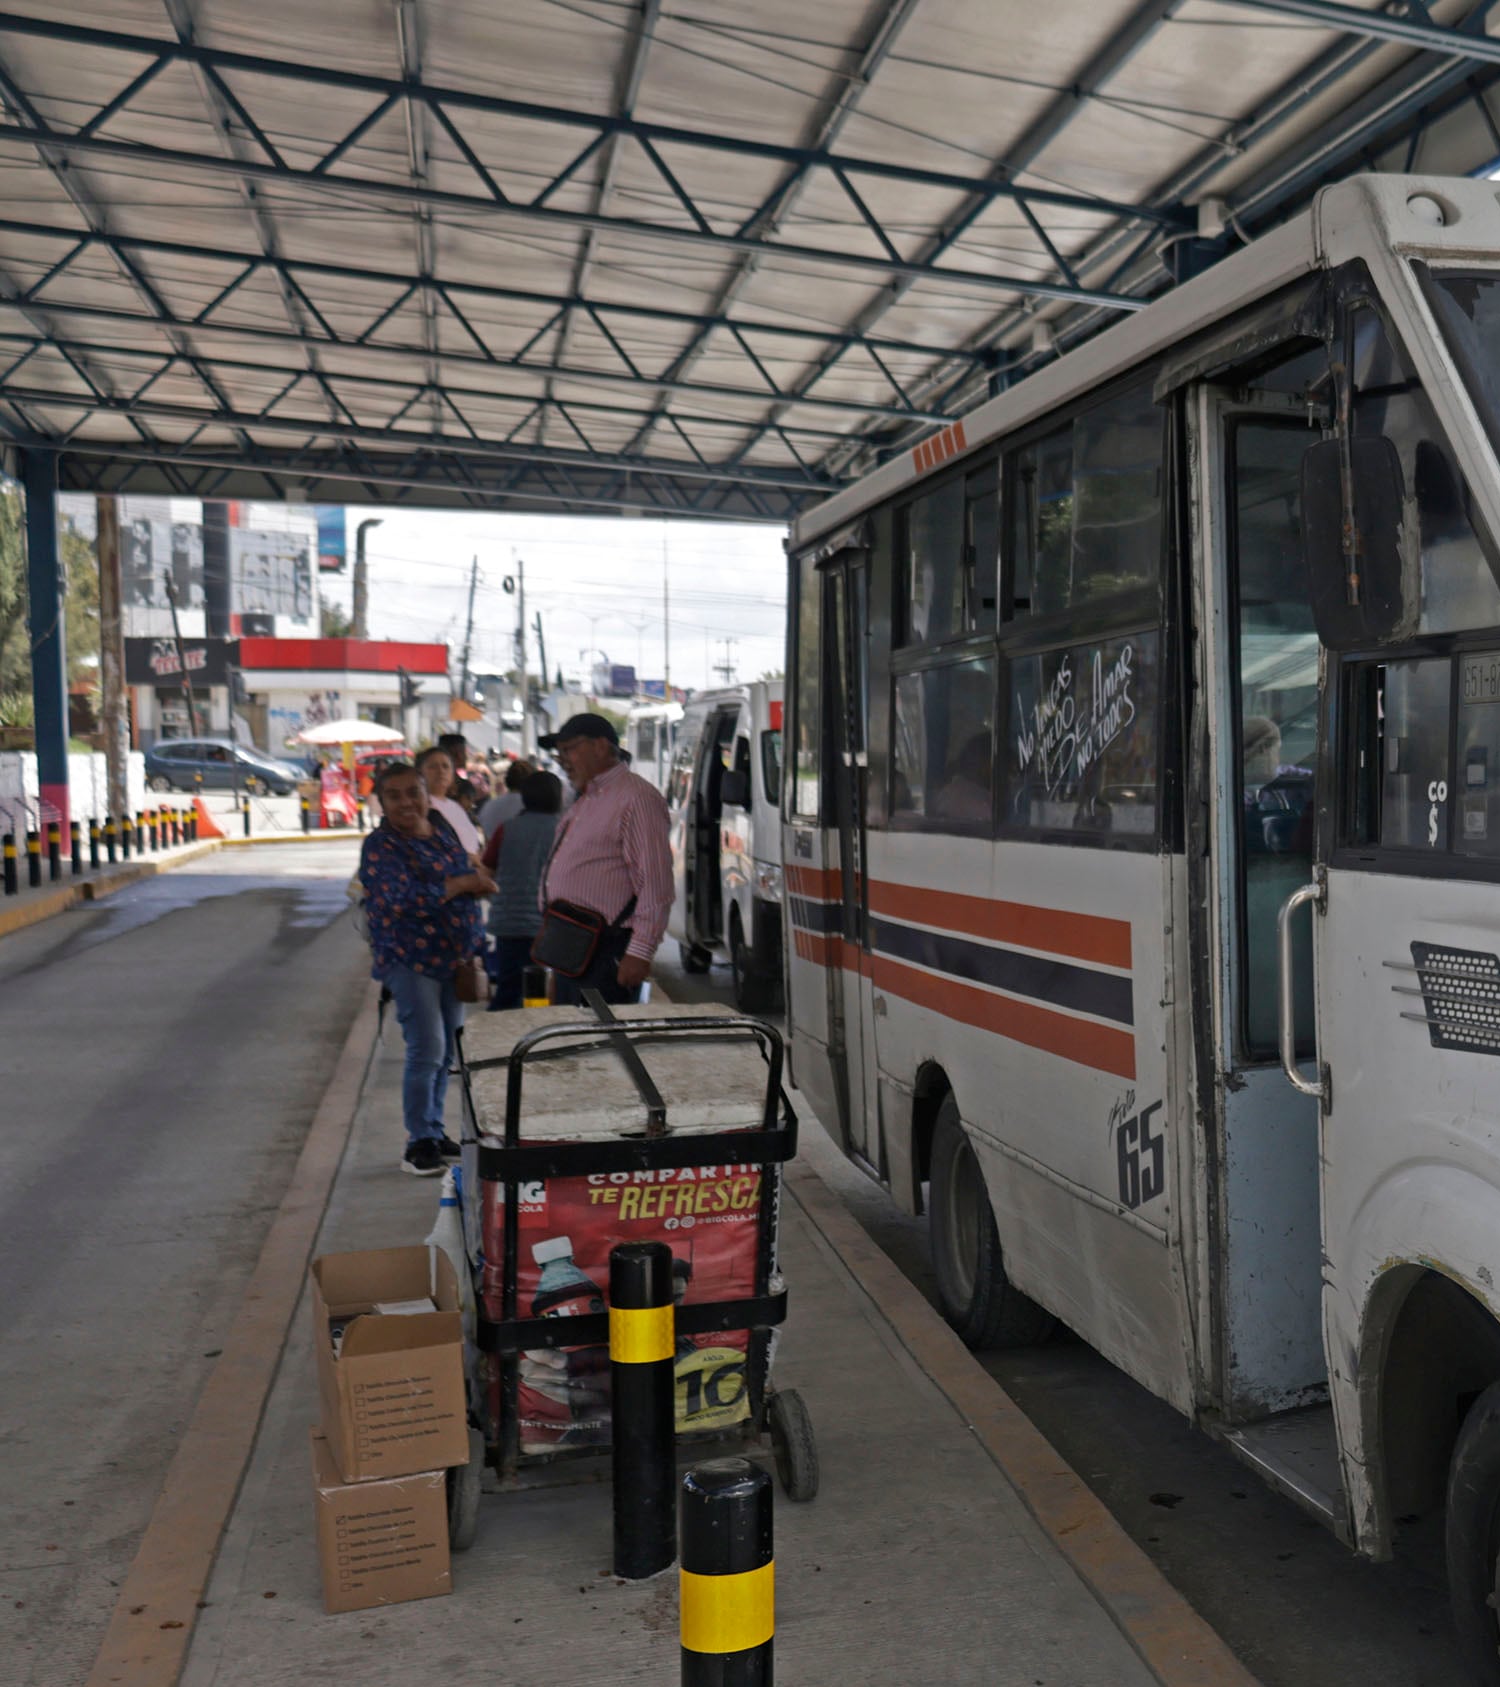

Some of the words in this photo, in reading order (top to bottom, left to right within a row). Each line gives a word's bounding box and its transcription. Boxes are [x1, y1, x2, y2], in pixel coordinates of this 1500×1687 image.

[154, 651, 204, 674] TECTE
[1117, 1098, 1164, 1211] 65
[588, 1188, 618, 1205] TE
[677, 1361, 748, 1415] 10
